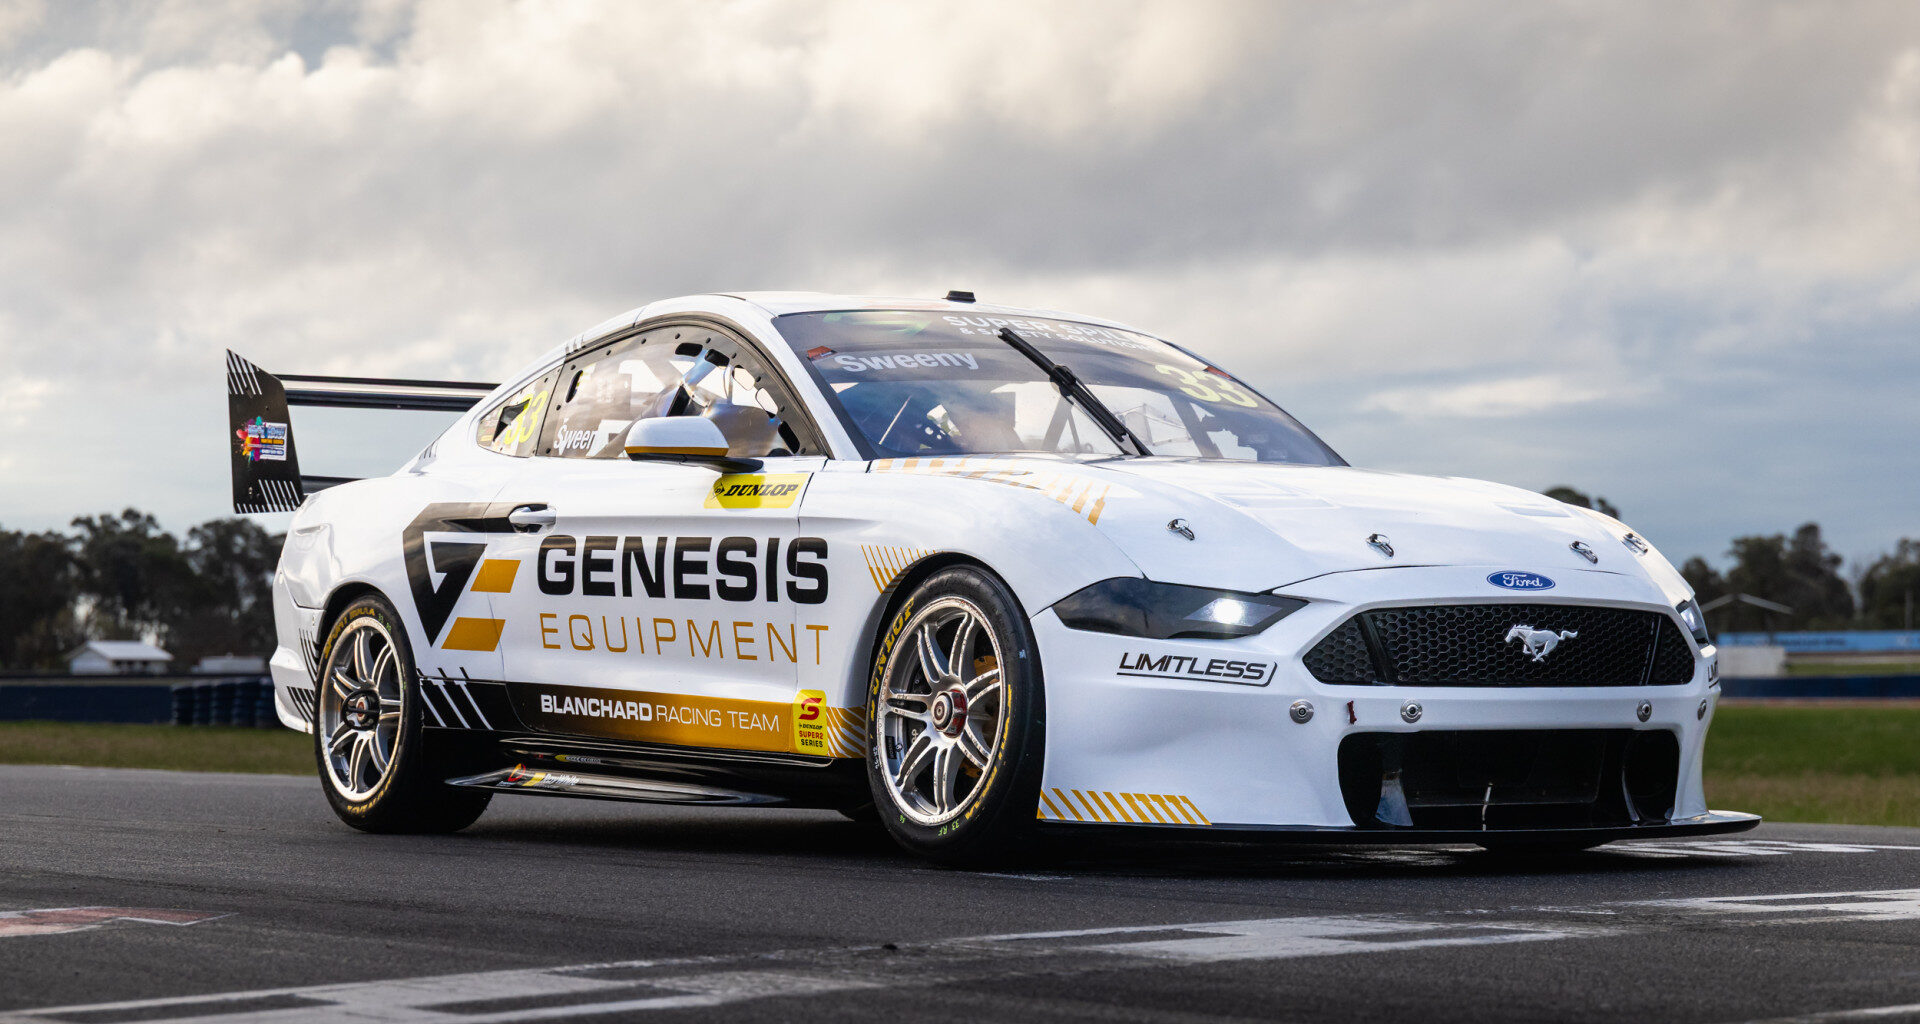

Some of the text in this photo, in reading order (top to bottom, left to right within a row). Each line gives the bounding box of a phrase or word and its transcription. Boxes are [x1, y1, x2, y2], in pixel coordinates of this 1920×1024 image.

[942, 316, 1056, 333] SUPER
[959, 328, 975, 336] &
[977, 328, 1052, 340] SAETY
[834, 353, 979, 372] Sweeny
[1155, 364, 1258, 408] 33
[723, 484, 798, 496] DUNLOP
[537, 535, 828, 604] GENESIS
[1502, 573, 1543, 587] Ford
[540, 613, 828, 665] EQUIPMENT
[1119, 652, 1267, 680] LIMITLESS
[541, 694, 780, 732] BLANCHARD RACING TEAM
[799, 731, 823, 739] SUPER2
[801, 739, 823, 747] SERIES
